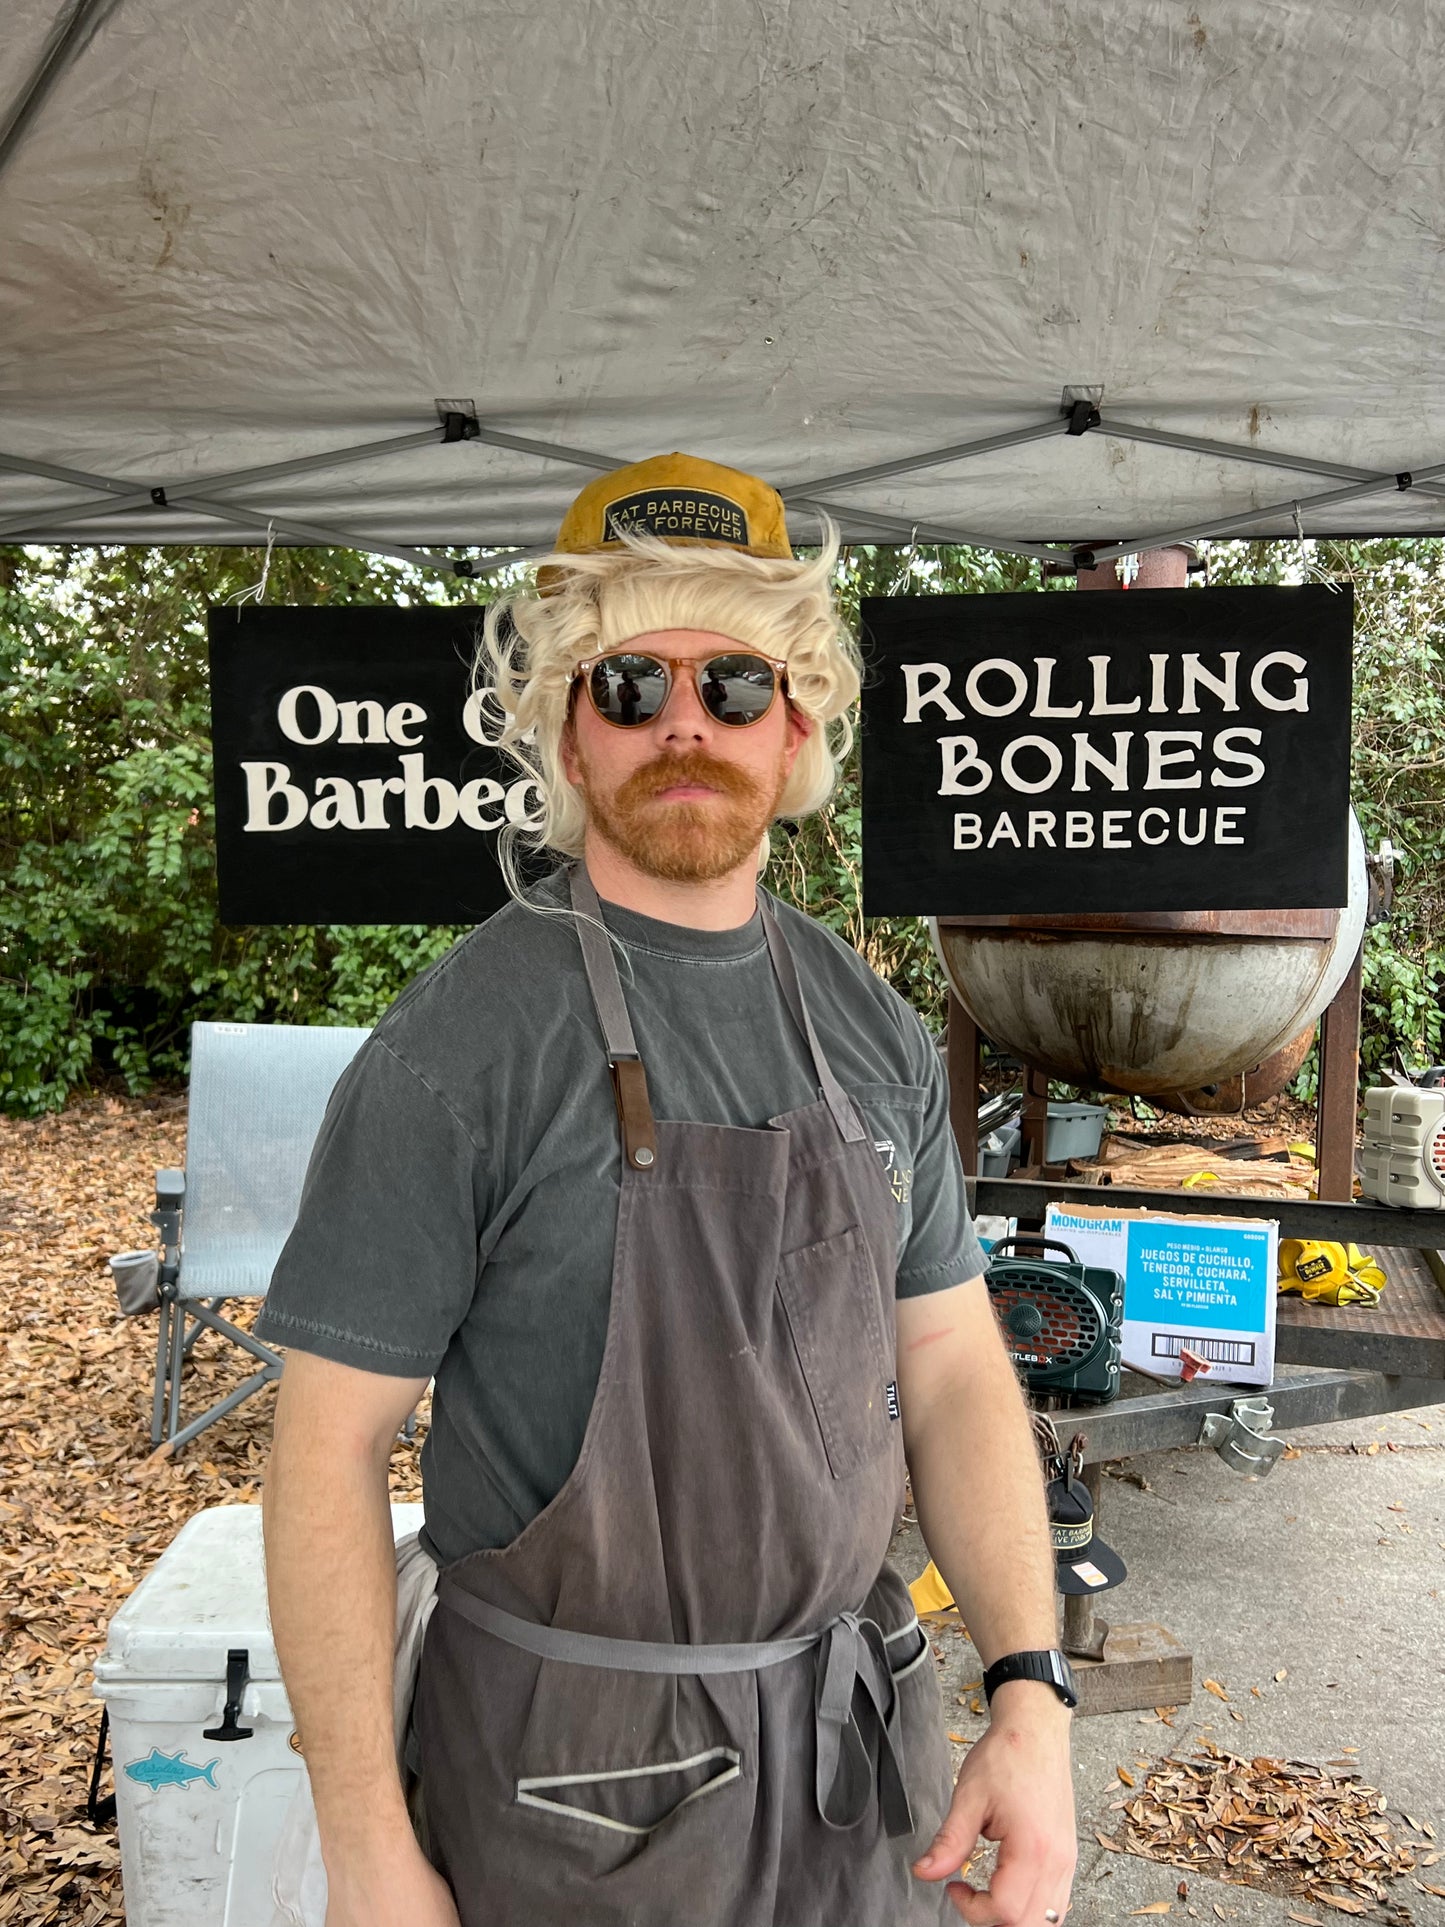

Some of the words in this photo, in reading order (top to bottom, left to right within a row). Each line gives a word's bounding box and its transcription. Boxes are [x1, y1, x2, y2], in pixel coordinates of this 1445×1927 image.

[611, 505, 640, 526] EAT
[646, 500, 741, 526] BARBECUE
[608, 518, 647, 540] LVE
[654, 516, 742, 541] FOREVER
[900, 651, 1309, 724] ROLLING
[277, 685, 428, 747] One
[937, 727, 1266, 797] BONES
[240, 753, 548, 832] Barbec
[953, 806, 1247, 851] BARBECUE
[1140, 1248, 1180, 1262] JUEGOS
[1182, 1252, 1196, 1264] DE
[1198, 1254, 1255, 1271] CUCHILLO,
[1166, 1242, 1181, 1251] PESO
[1182, 1244, 1201, 1252] MEDIO
[1205, 1245, 1229, 1255] BLANCO
[1142, 1261, 1194, 1278] TENEDOR,
[1196, 1266, 1251, 1283] CUCHARA,
[1153, 1288, 1174, 1301] SAL
[1176, 1290, 1184, 1302] Y
[1186, 1291, 1238, 1307] PIMIENTA
[1162, 1276, 1230, 1294] SERVILLETA,
[886, 1384, 899, 1417] TILIT
[1054, 1536, 1069, 1544] IVE
